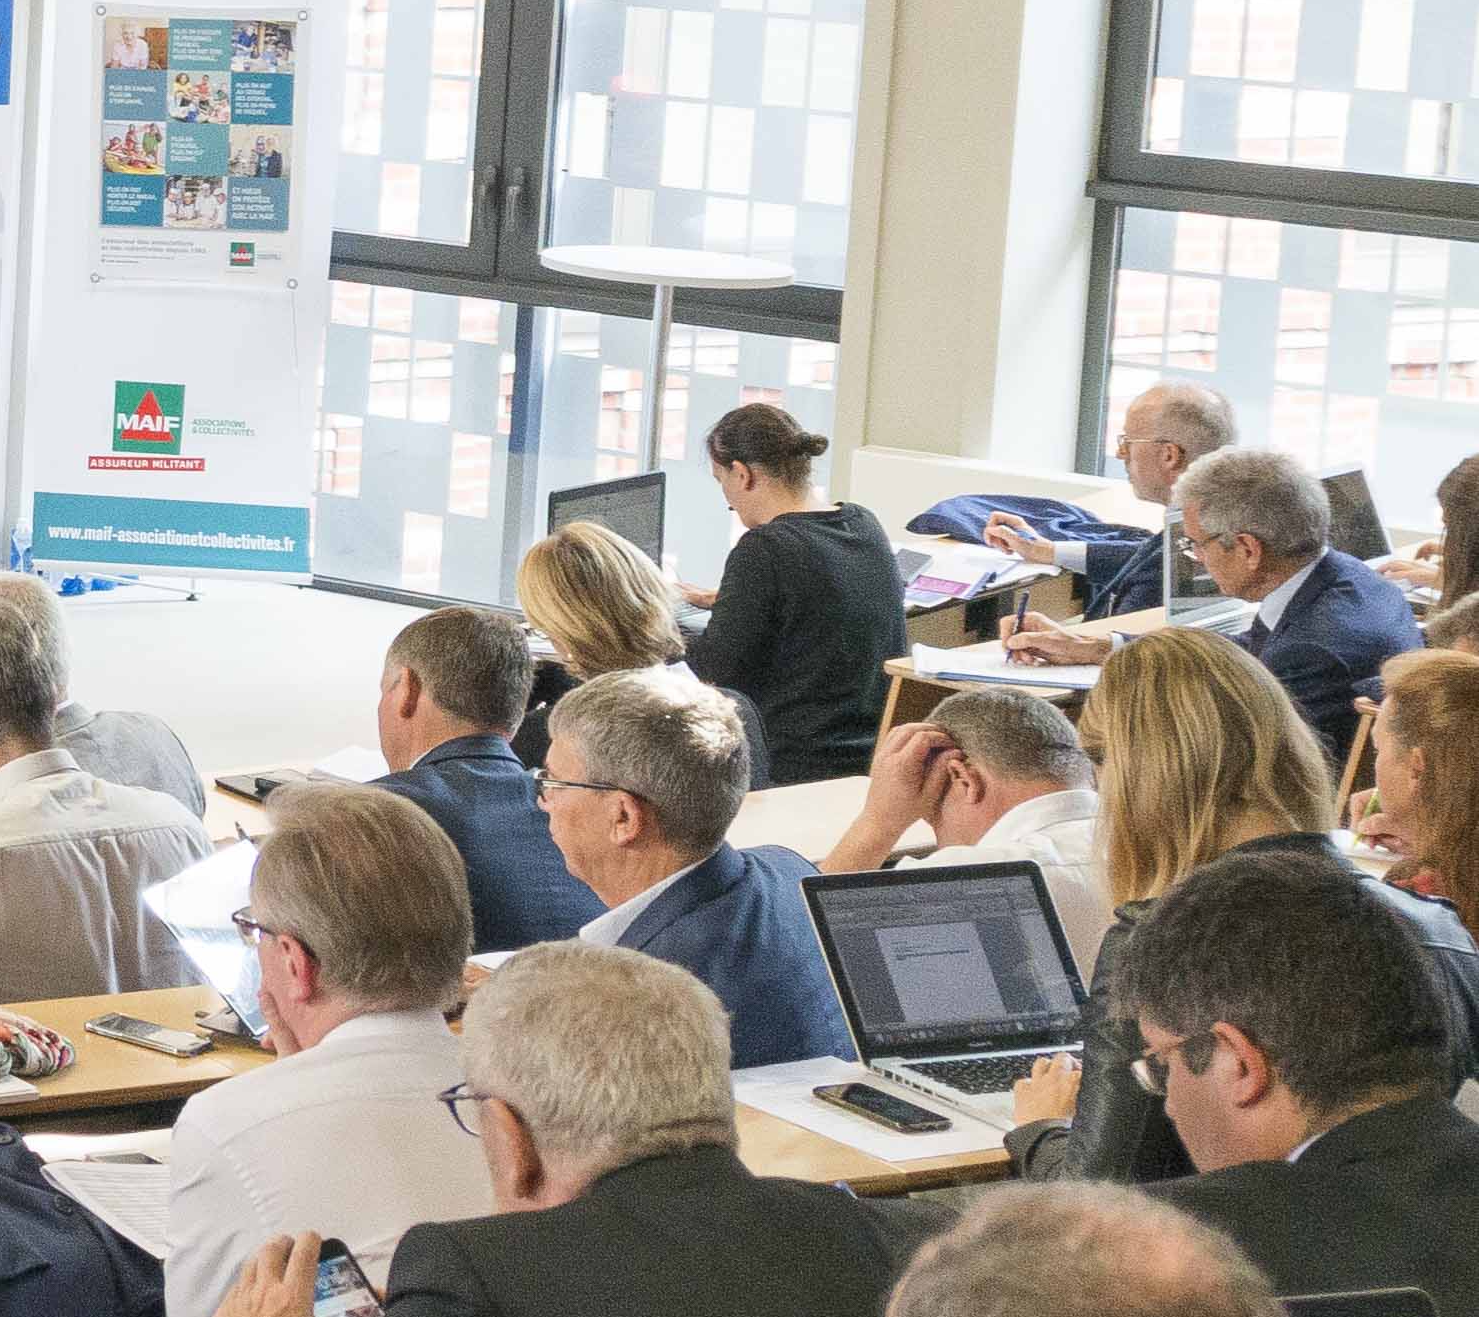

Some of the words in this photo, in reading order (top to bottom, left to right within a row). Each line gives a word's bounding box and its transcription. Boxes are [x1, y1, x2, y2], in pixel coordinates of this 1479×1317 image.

[115, 413, 181, 432] MAIF
[192, 418, 246, 429] ASSOCIATIONS
[89, 458, 149, 469] ASSUREUR
[152, 459, 204, 470] MILITANT.
